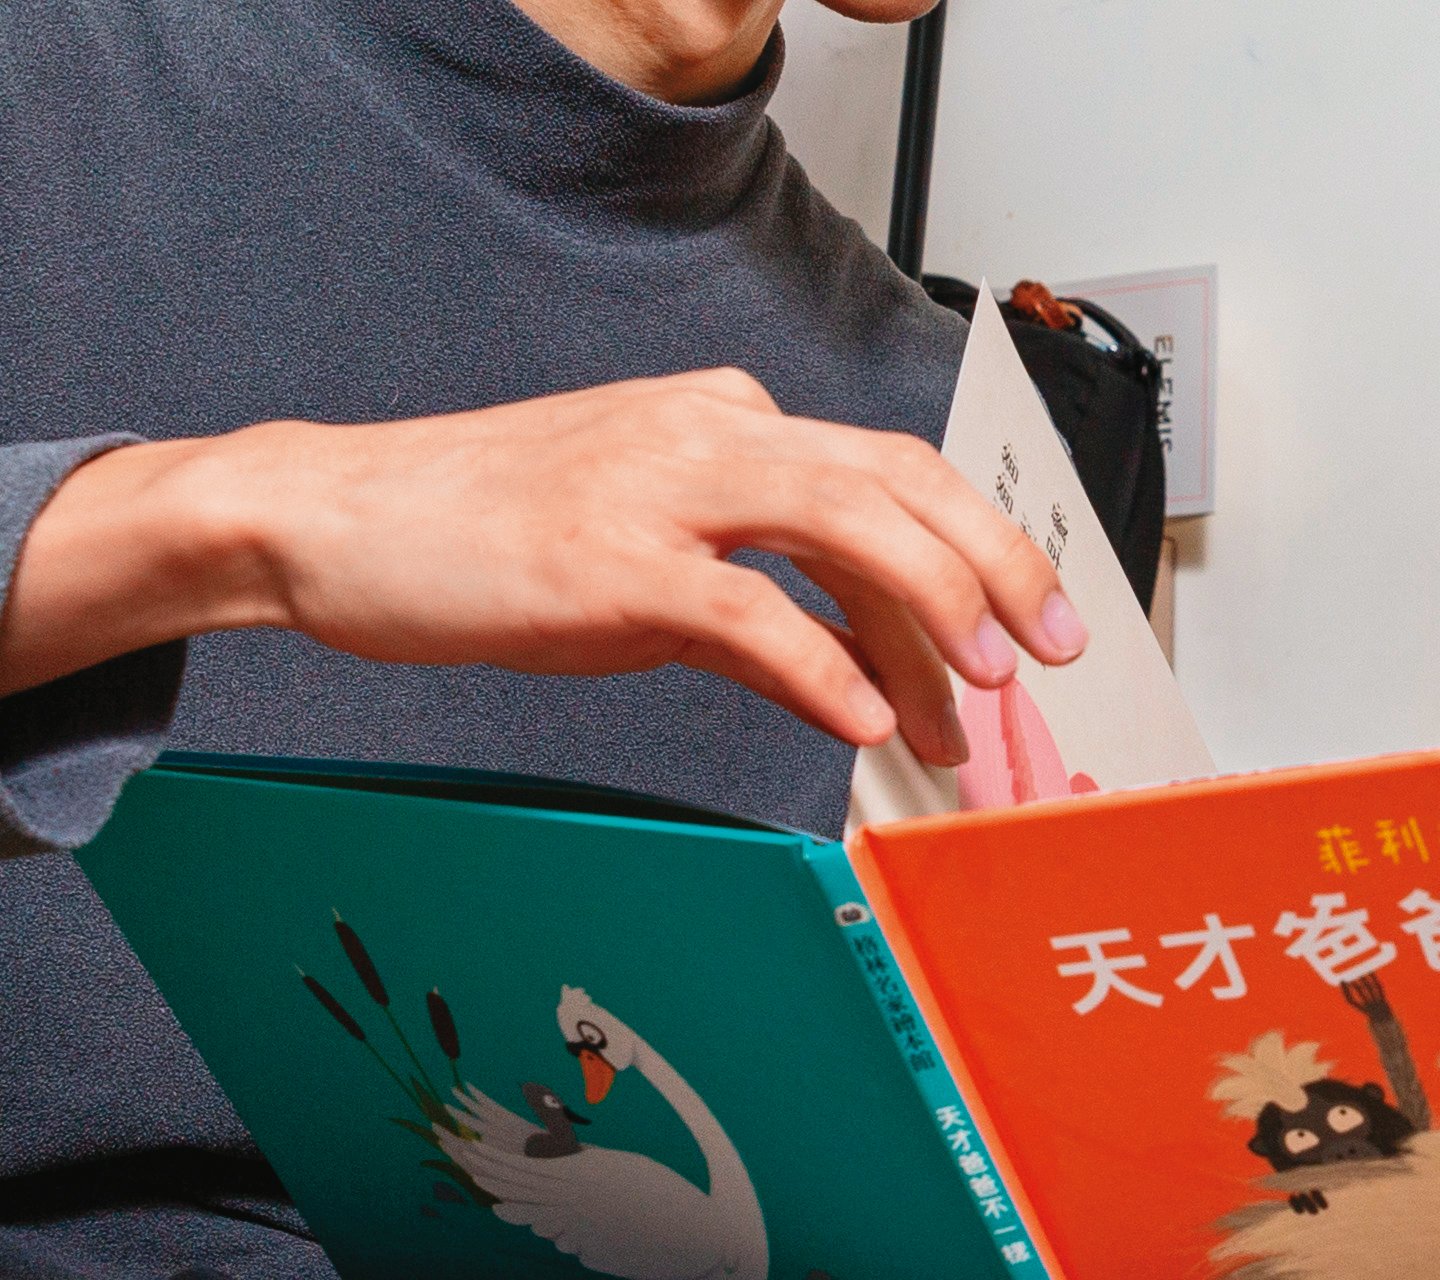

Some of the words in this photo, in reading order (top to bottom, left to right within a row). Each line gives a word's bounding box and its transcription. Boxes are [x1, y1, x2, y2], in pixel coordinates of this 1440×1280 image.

[936, 1104, 1031, 1265] 天才爸爸不一樣
